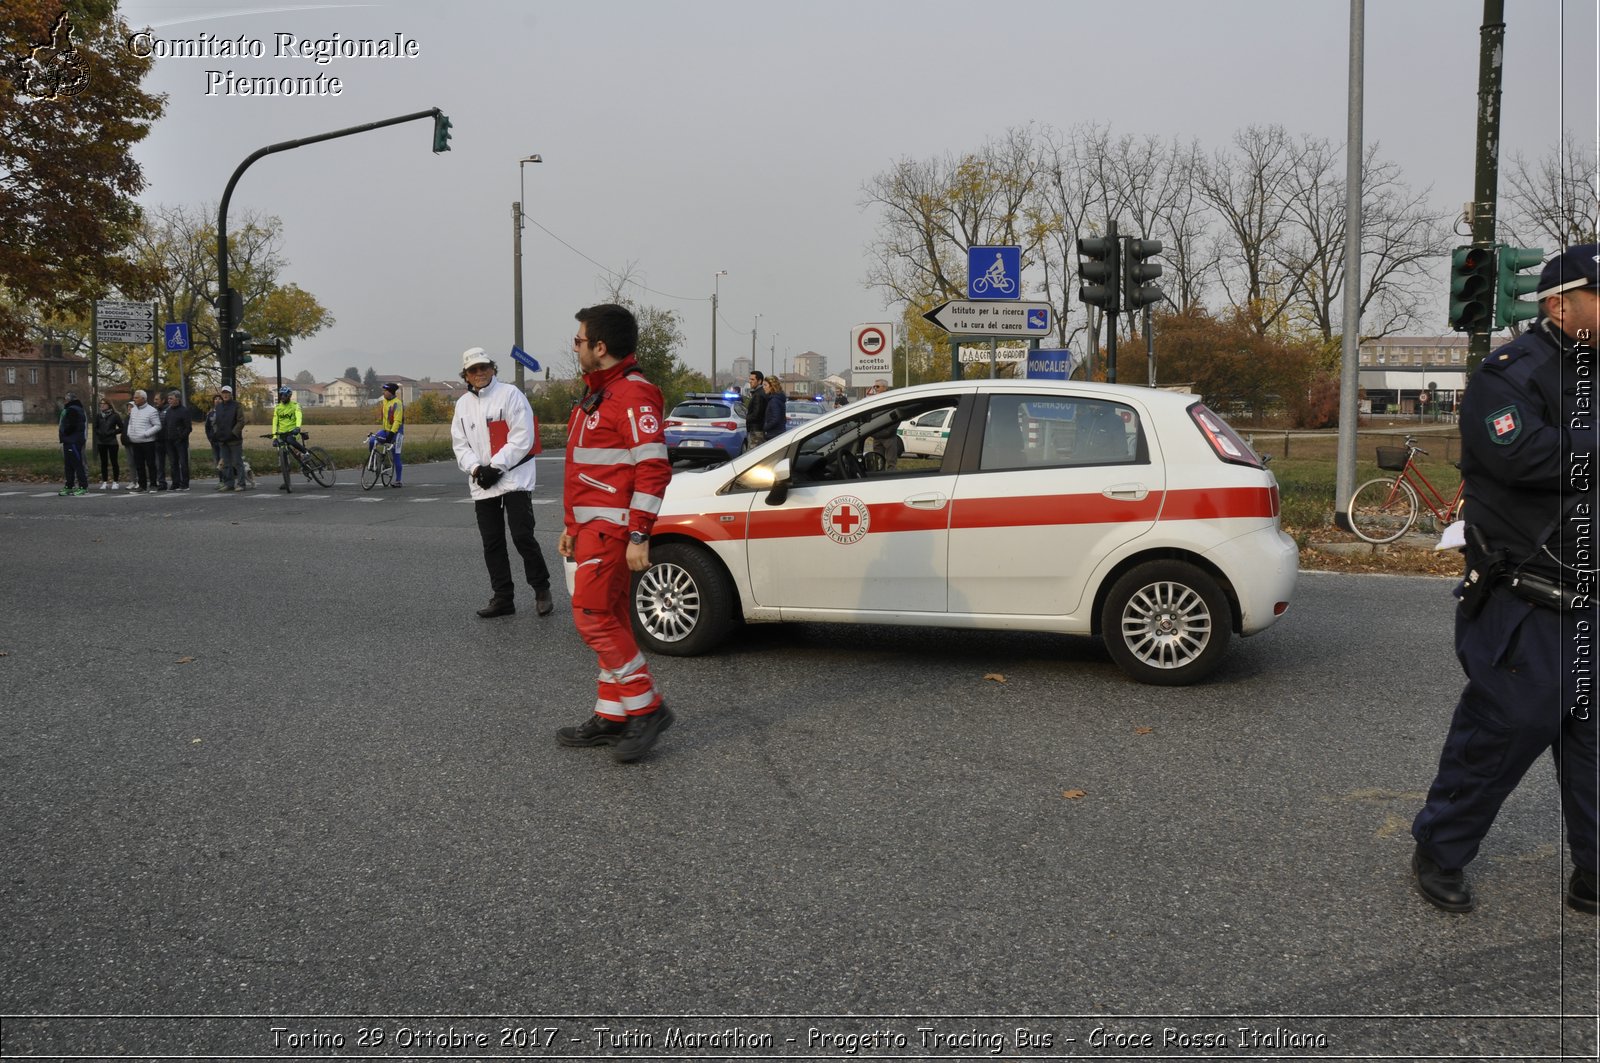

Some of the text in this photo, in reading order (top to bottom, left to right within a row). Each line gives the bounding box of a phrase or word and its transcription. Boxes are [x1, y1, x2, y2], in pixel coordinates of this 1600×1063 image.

[951, 306, 1025, 316] Istituto per la ricerca
[961, 321, 968, 329] la
[988, 322, 998, 330] del
[825, 526, 866, 543] NICHELINO
